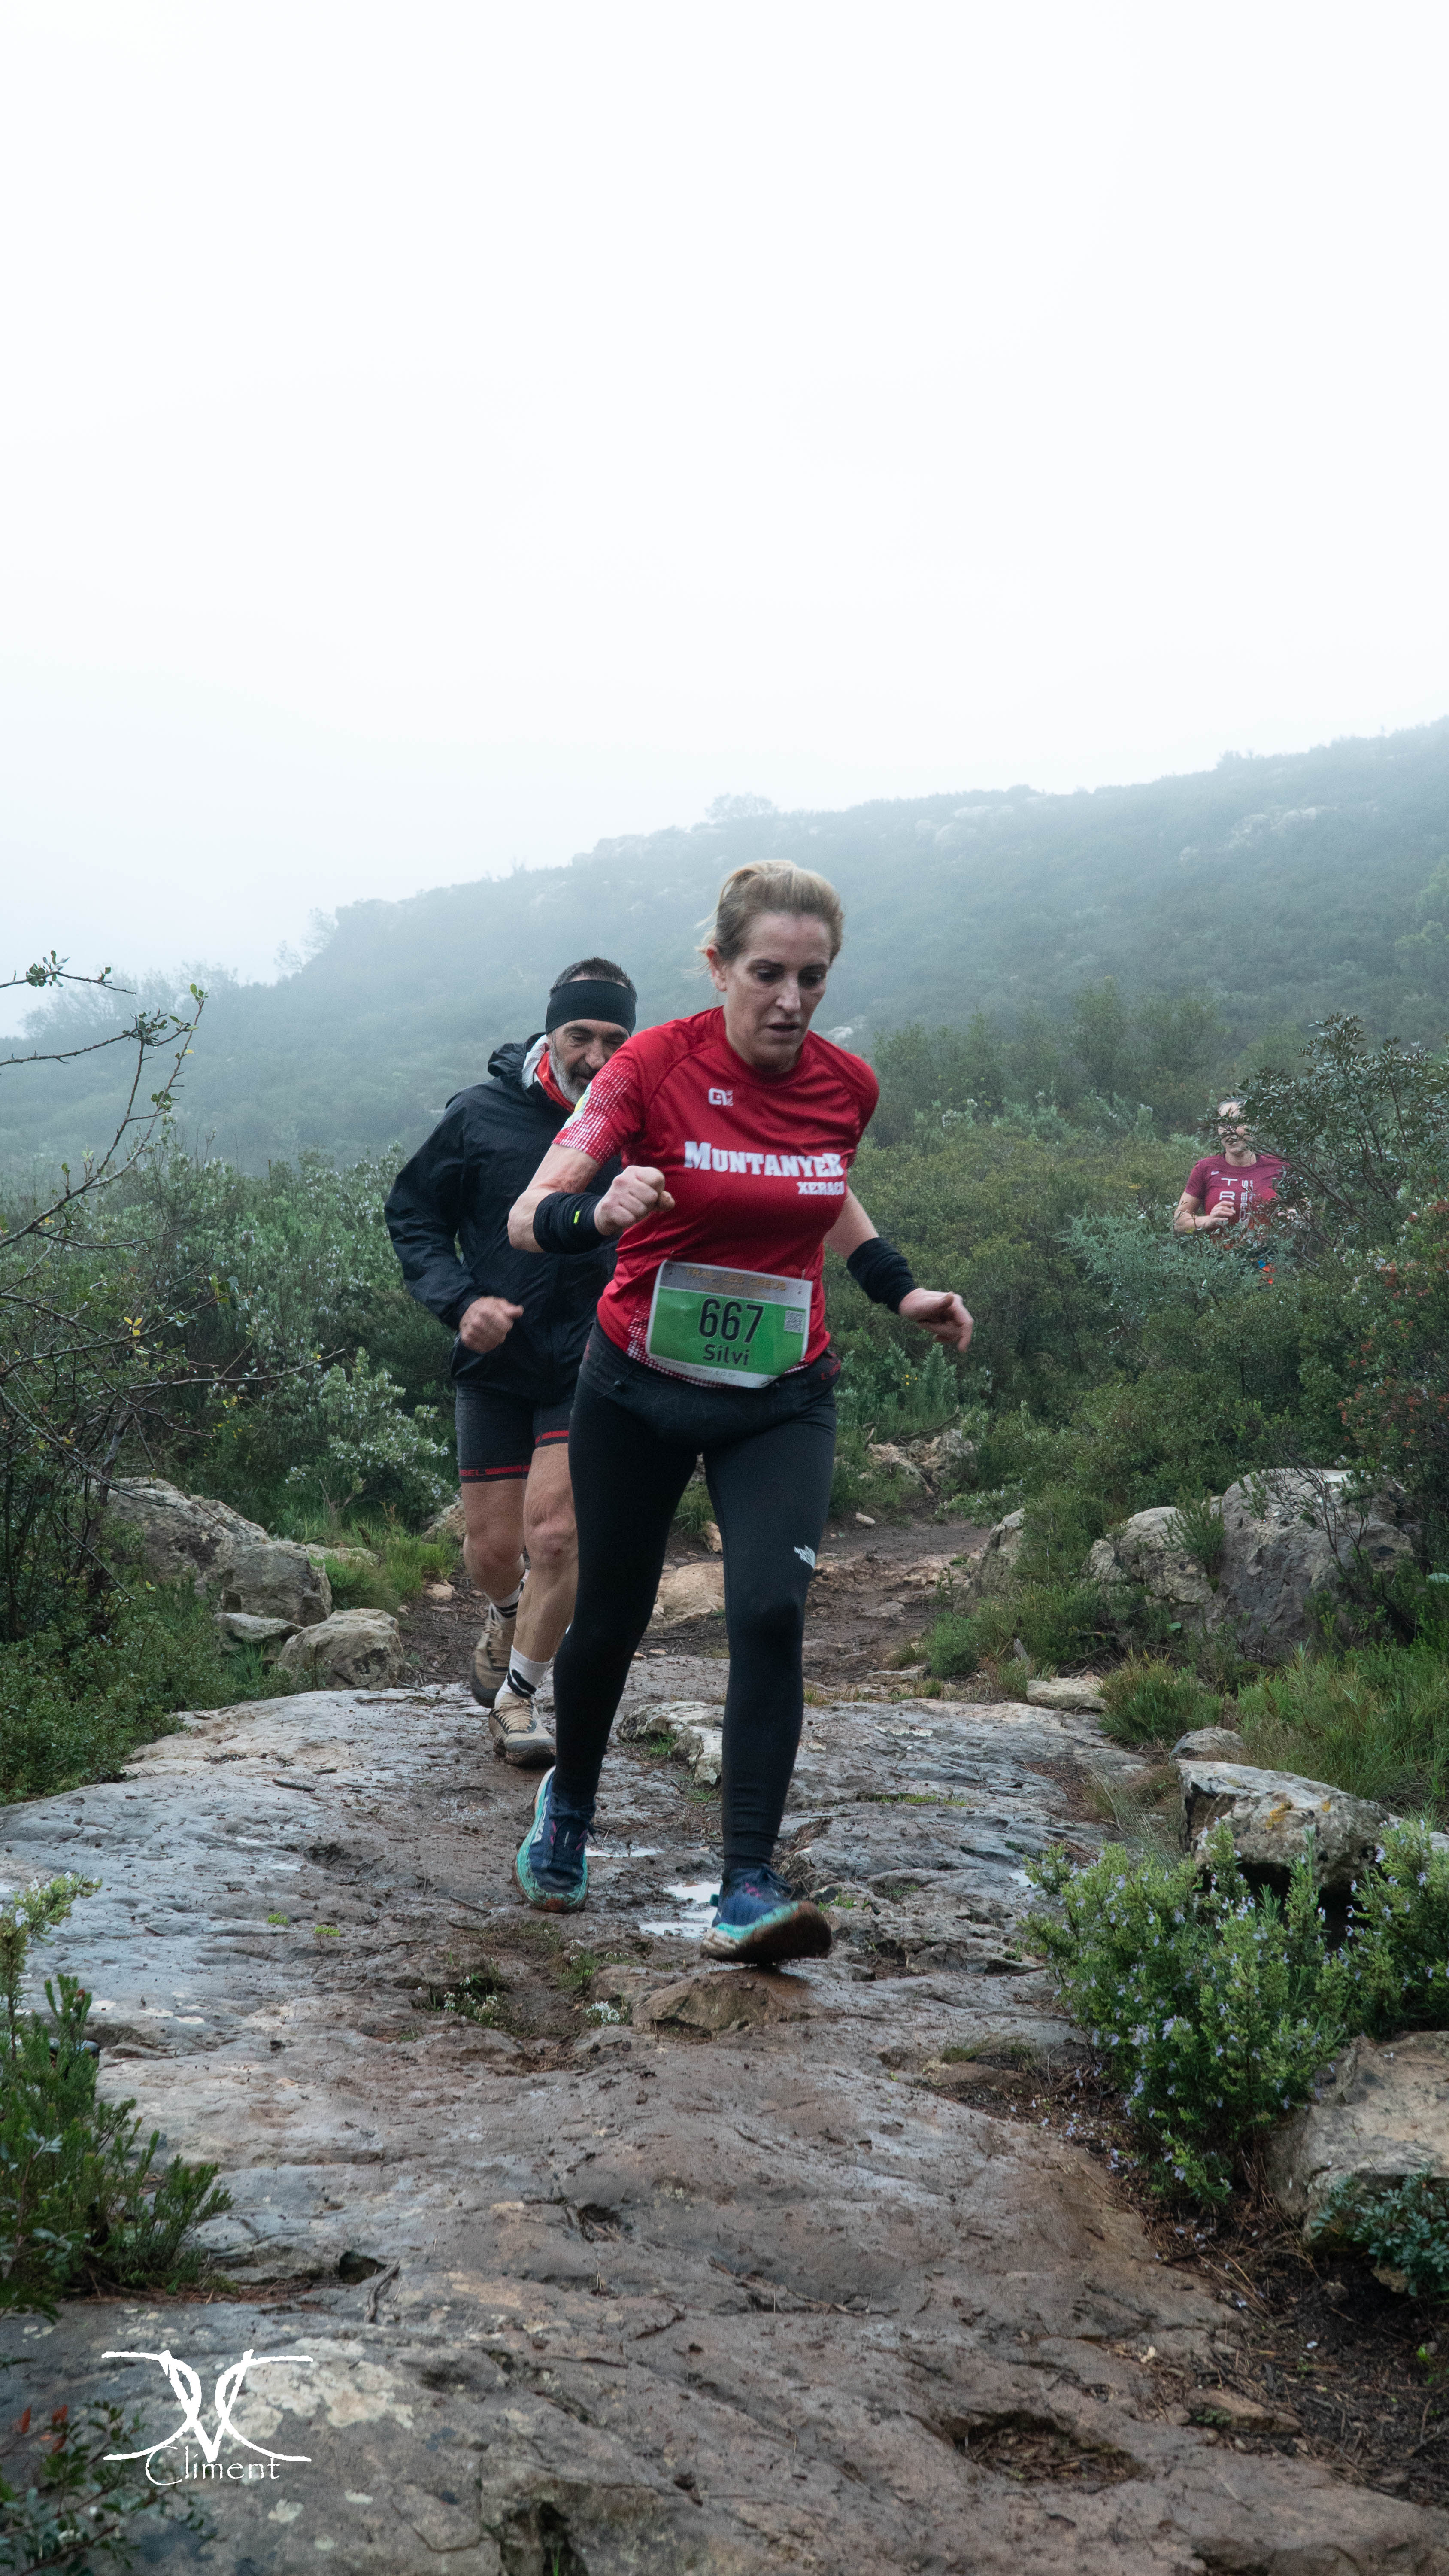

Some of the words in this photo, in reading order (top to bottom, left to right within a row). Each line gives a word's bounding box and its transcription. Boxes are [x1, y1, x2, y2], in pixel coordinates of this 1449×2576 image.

[684, 1141, 844, 1177] MUNTANYER
[699, 1297, 764, 1343] 667
[703, 1344, 750, 1366] Silvi
